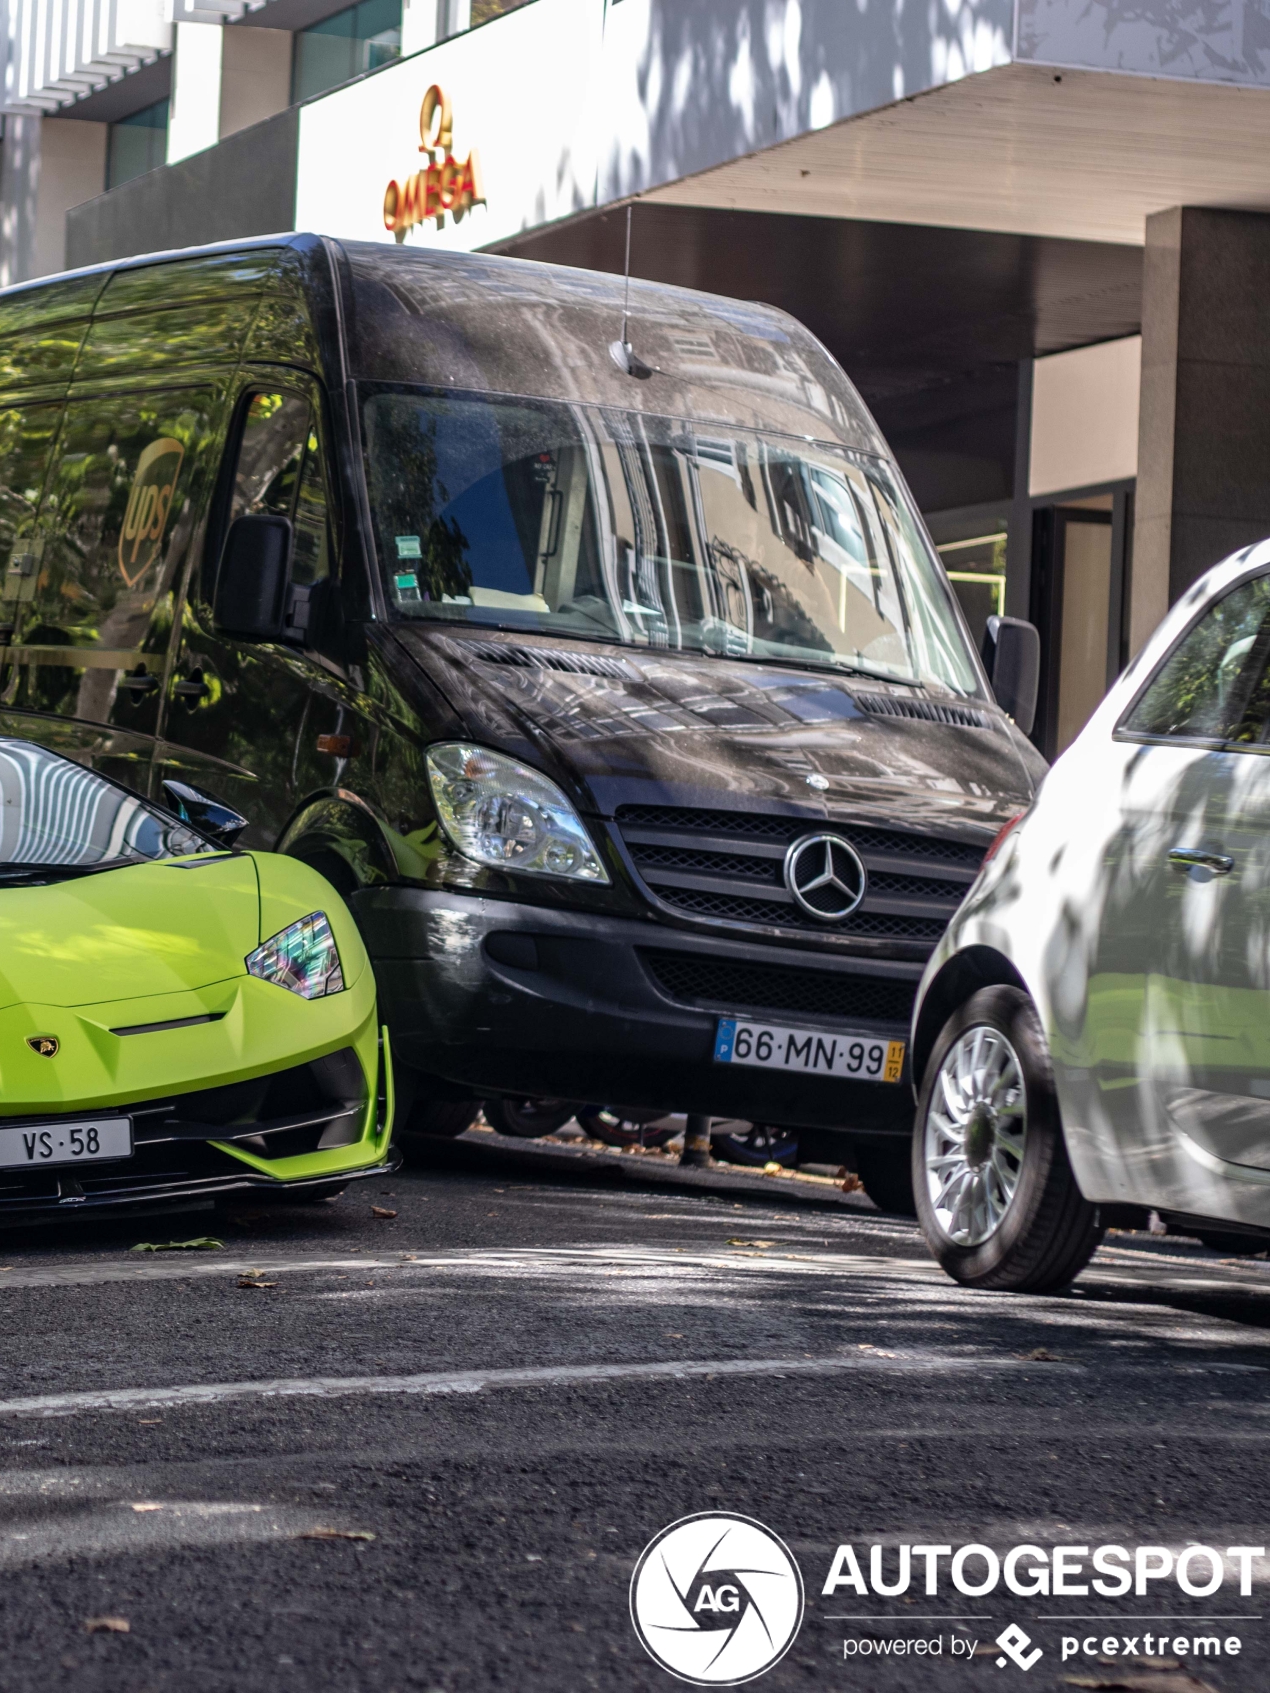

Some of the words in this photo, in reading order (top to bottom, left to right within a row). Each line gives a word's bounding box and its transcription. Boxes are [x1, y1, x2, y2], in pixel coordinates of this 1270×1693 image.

[384, 151, 486, 231] OMEGA
[125, 484, 172, 563] ups
[720, 1045, 728, 1054] P
[891, 1046, 903, 1059] 11
[888, 1066, 899, 1078] 12
